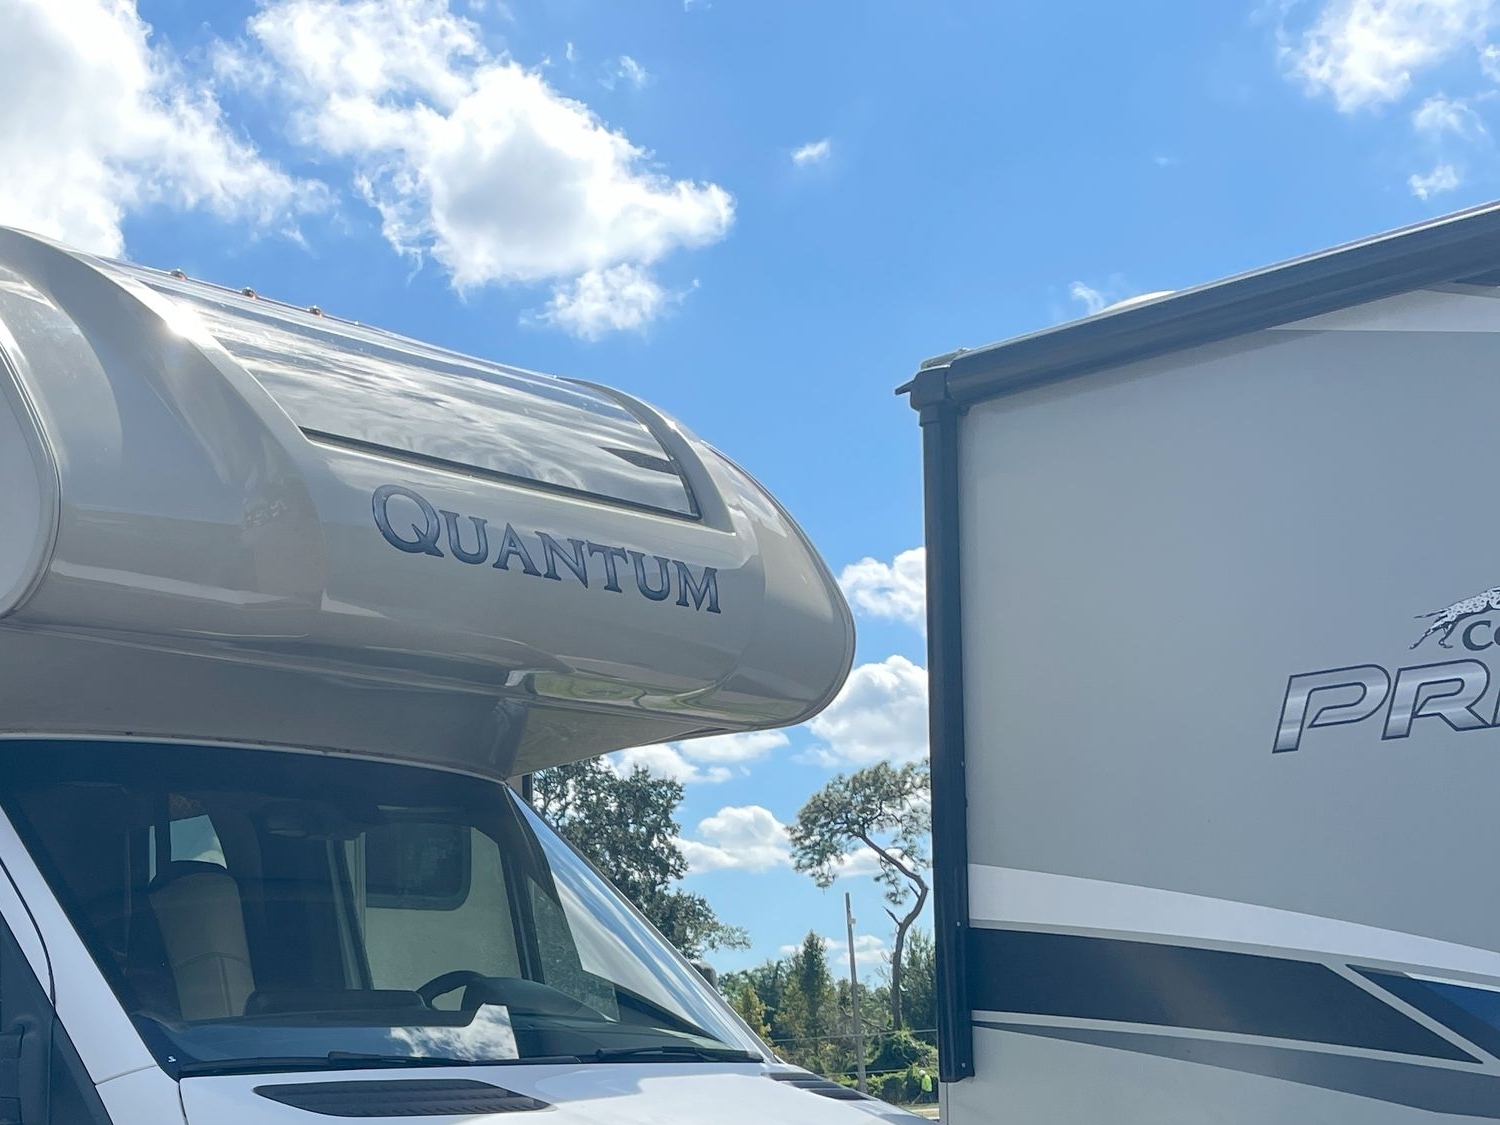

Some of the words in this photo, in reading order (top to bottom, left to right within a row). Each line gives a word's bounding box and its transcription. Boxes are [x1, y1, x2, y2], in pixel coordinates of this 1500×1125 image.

[371, 484, 721, 614] QUANTUM
[1462, 620, 1500, 651] C
[1272, 658, 1500, 754] PR
